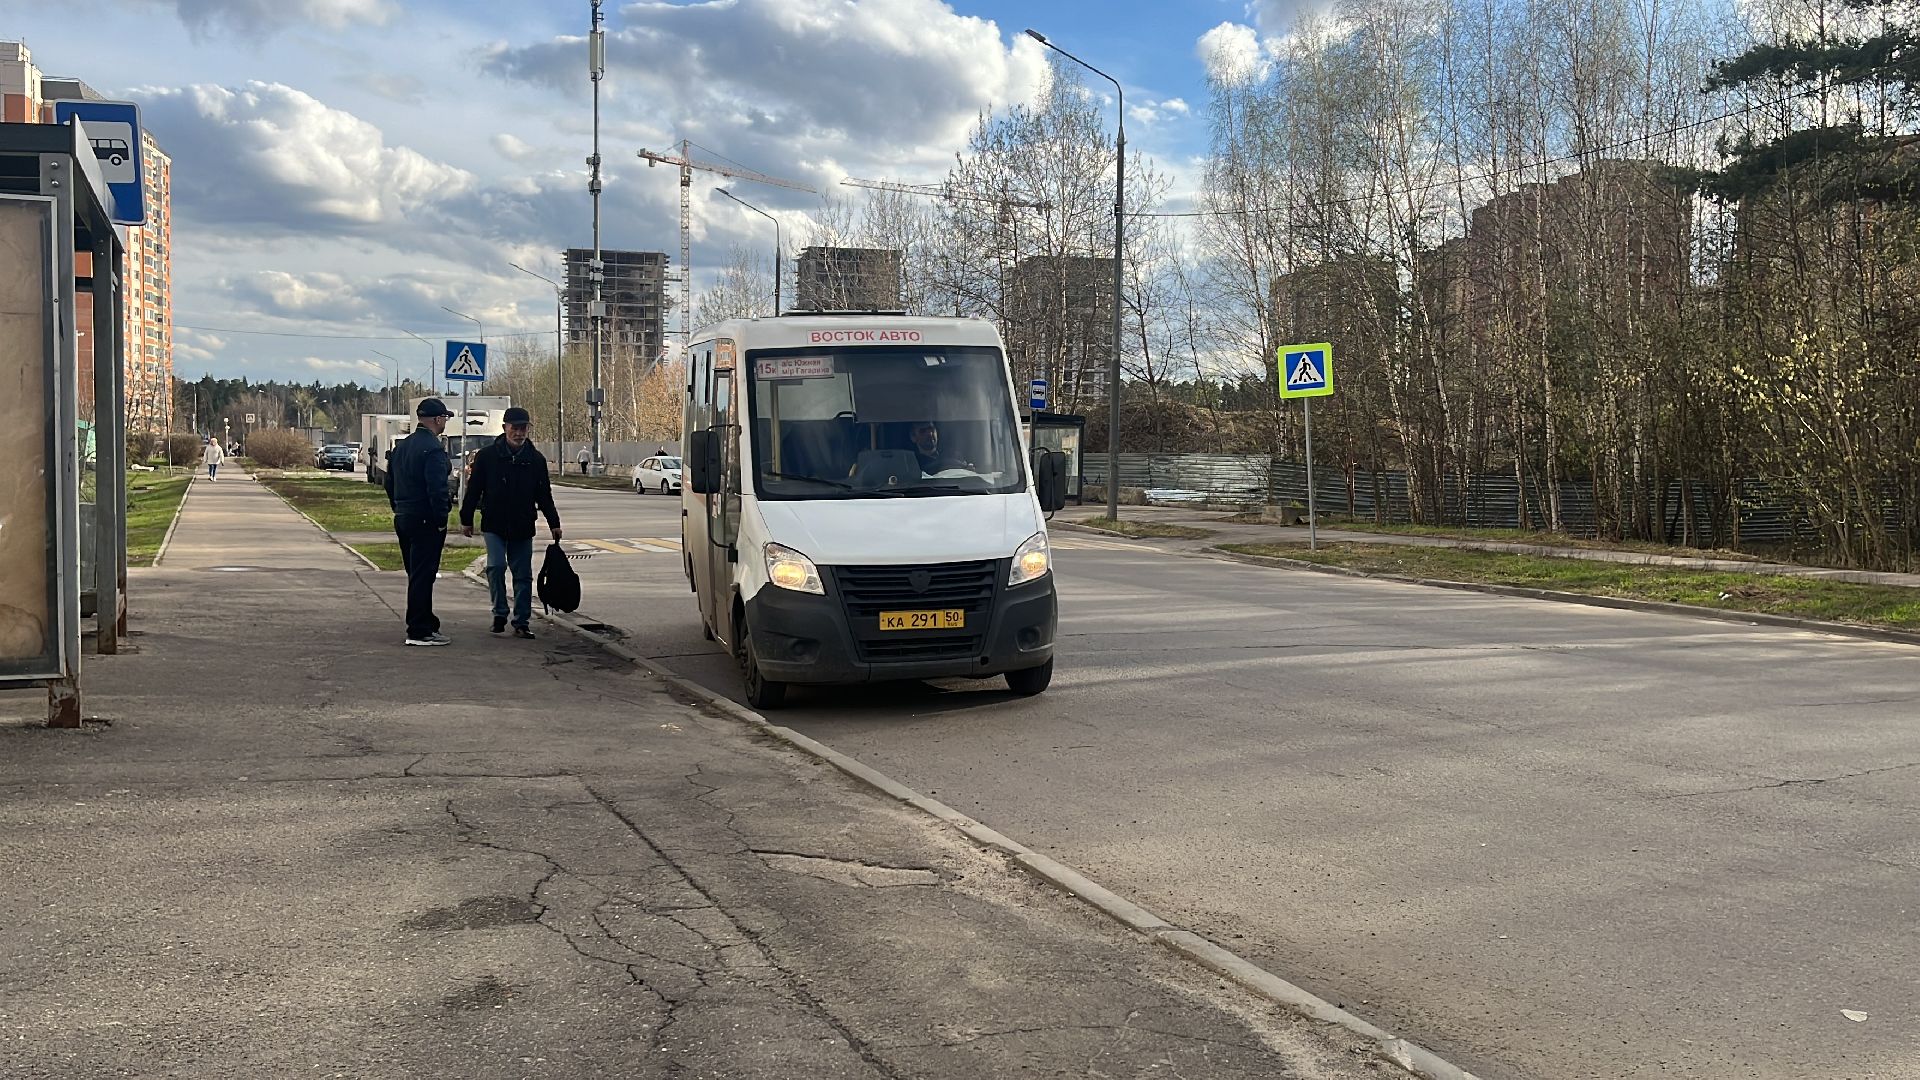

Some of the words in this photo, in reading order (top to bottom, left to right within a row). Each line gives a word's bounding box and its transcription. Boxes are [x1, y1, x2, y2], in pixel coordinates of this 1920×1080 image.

[811, 331, 875, 342] ВОСТОК
[880, 330, 920, 341] АВТО
[911, 613, 937, 627] 291
[945, 611, 959, 622] 50
